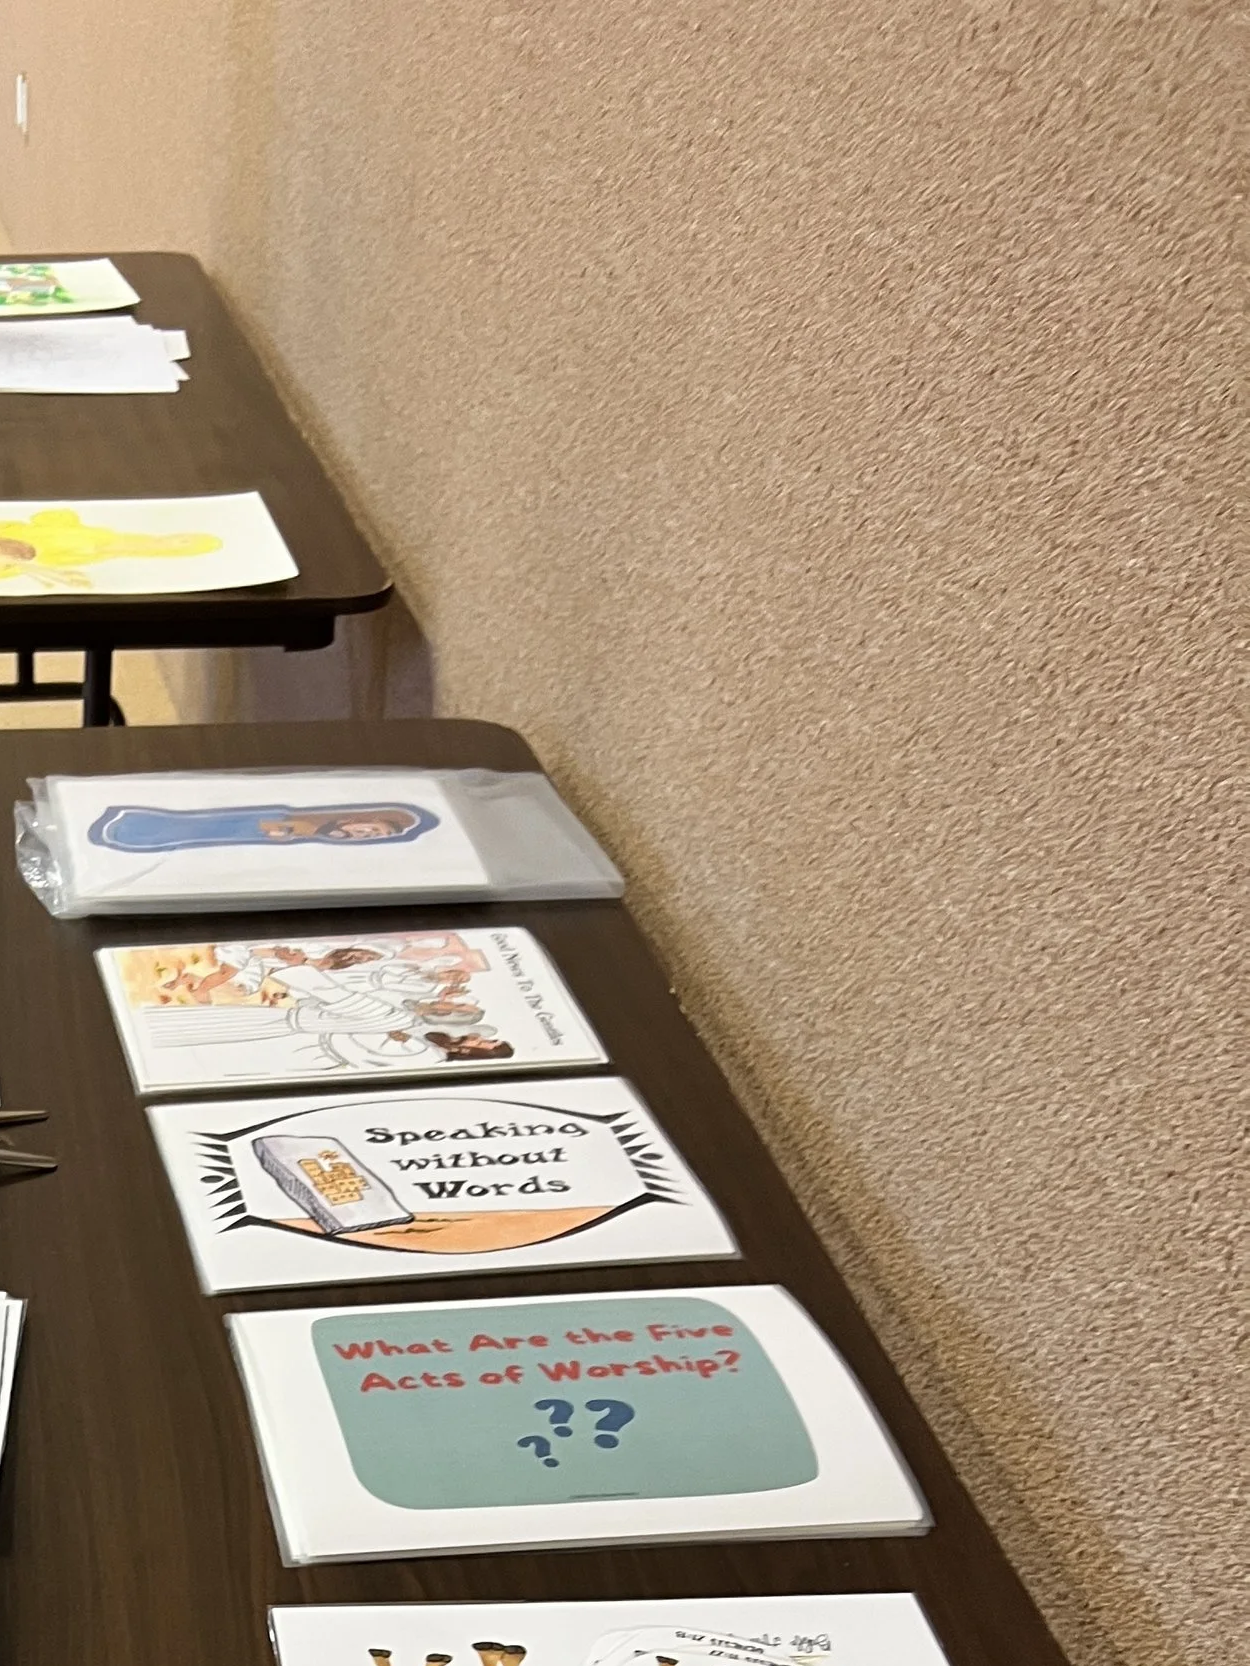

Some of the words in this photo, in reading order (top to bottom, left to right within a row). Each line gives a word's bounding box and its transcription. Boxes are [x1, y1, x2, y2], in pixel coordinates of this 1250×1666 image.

[365, 1119, 589, 1146] Speaking
[390, 1147, 567, 1171] without
[414, 1175, 571, 1200] Words
[334, 1338, 453, 1361] What
[468, 1332, 550, 1353] Are
[563, 1325, 637, 1345] the
[646, 1321, 736, 1342] Five
[360, 1368, 467, 1393] Acts
[478, 1364, 528, 1387] of
[538, 1350, 742, 1380] Worship?
